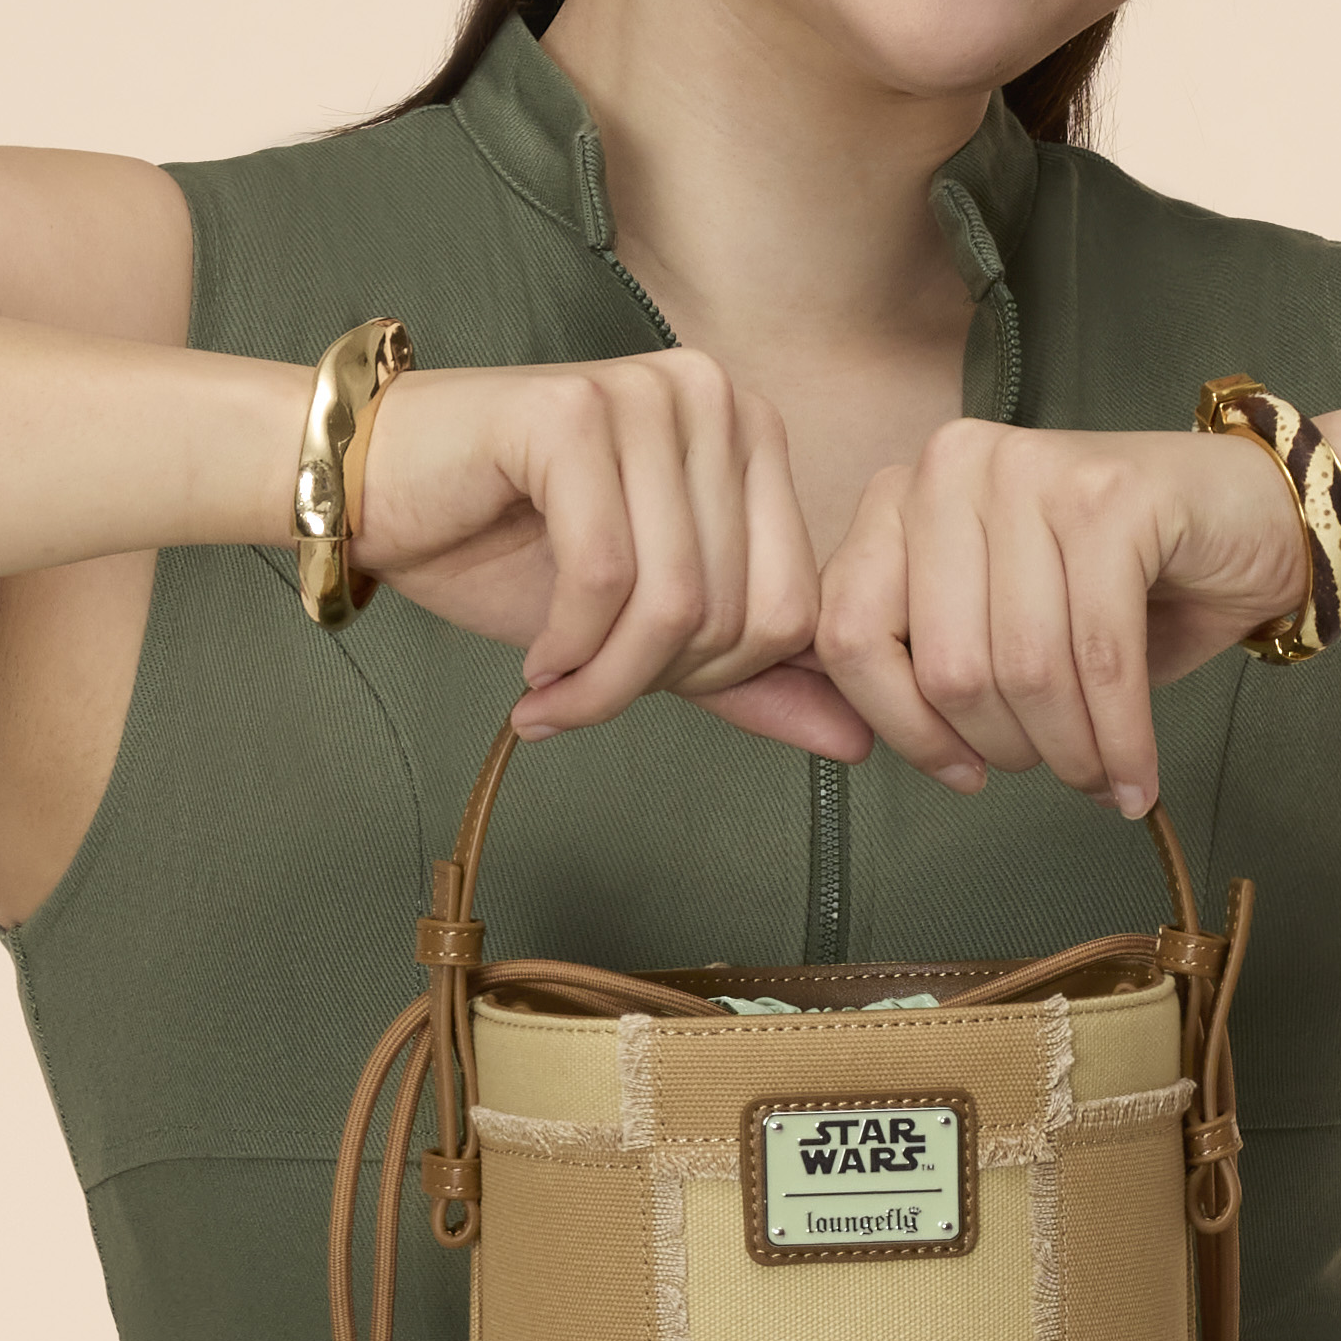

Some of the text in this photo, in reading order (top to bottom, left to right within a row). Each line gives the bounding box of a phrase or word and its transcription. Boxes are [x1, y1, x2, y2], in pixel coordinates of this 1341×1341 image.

[798, 1118, 926, 1146] STAR
[799, 1146, 926, 1175] WARS
[806, 1208, 919, 1236] loungefly
